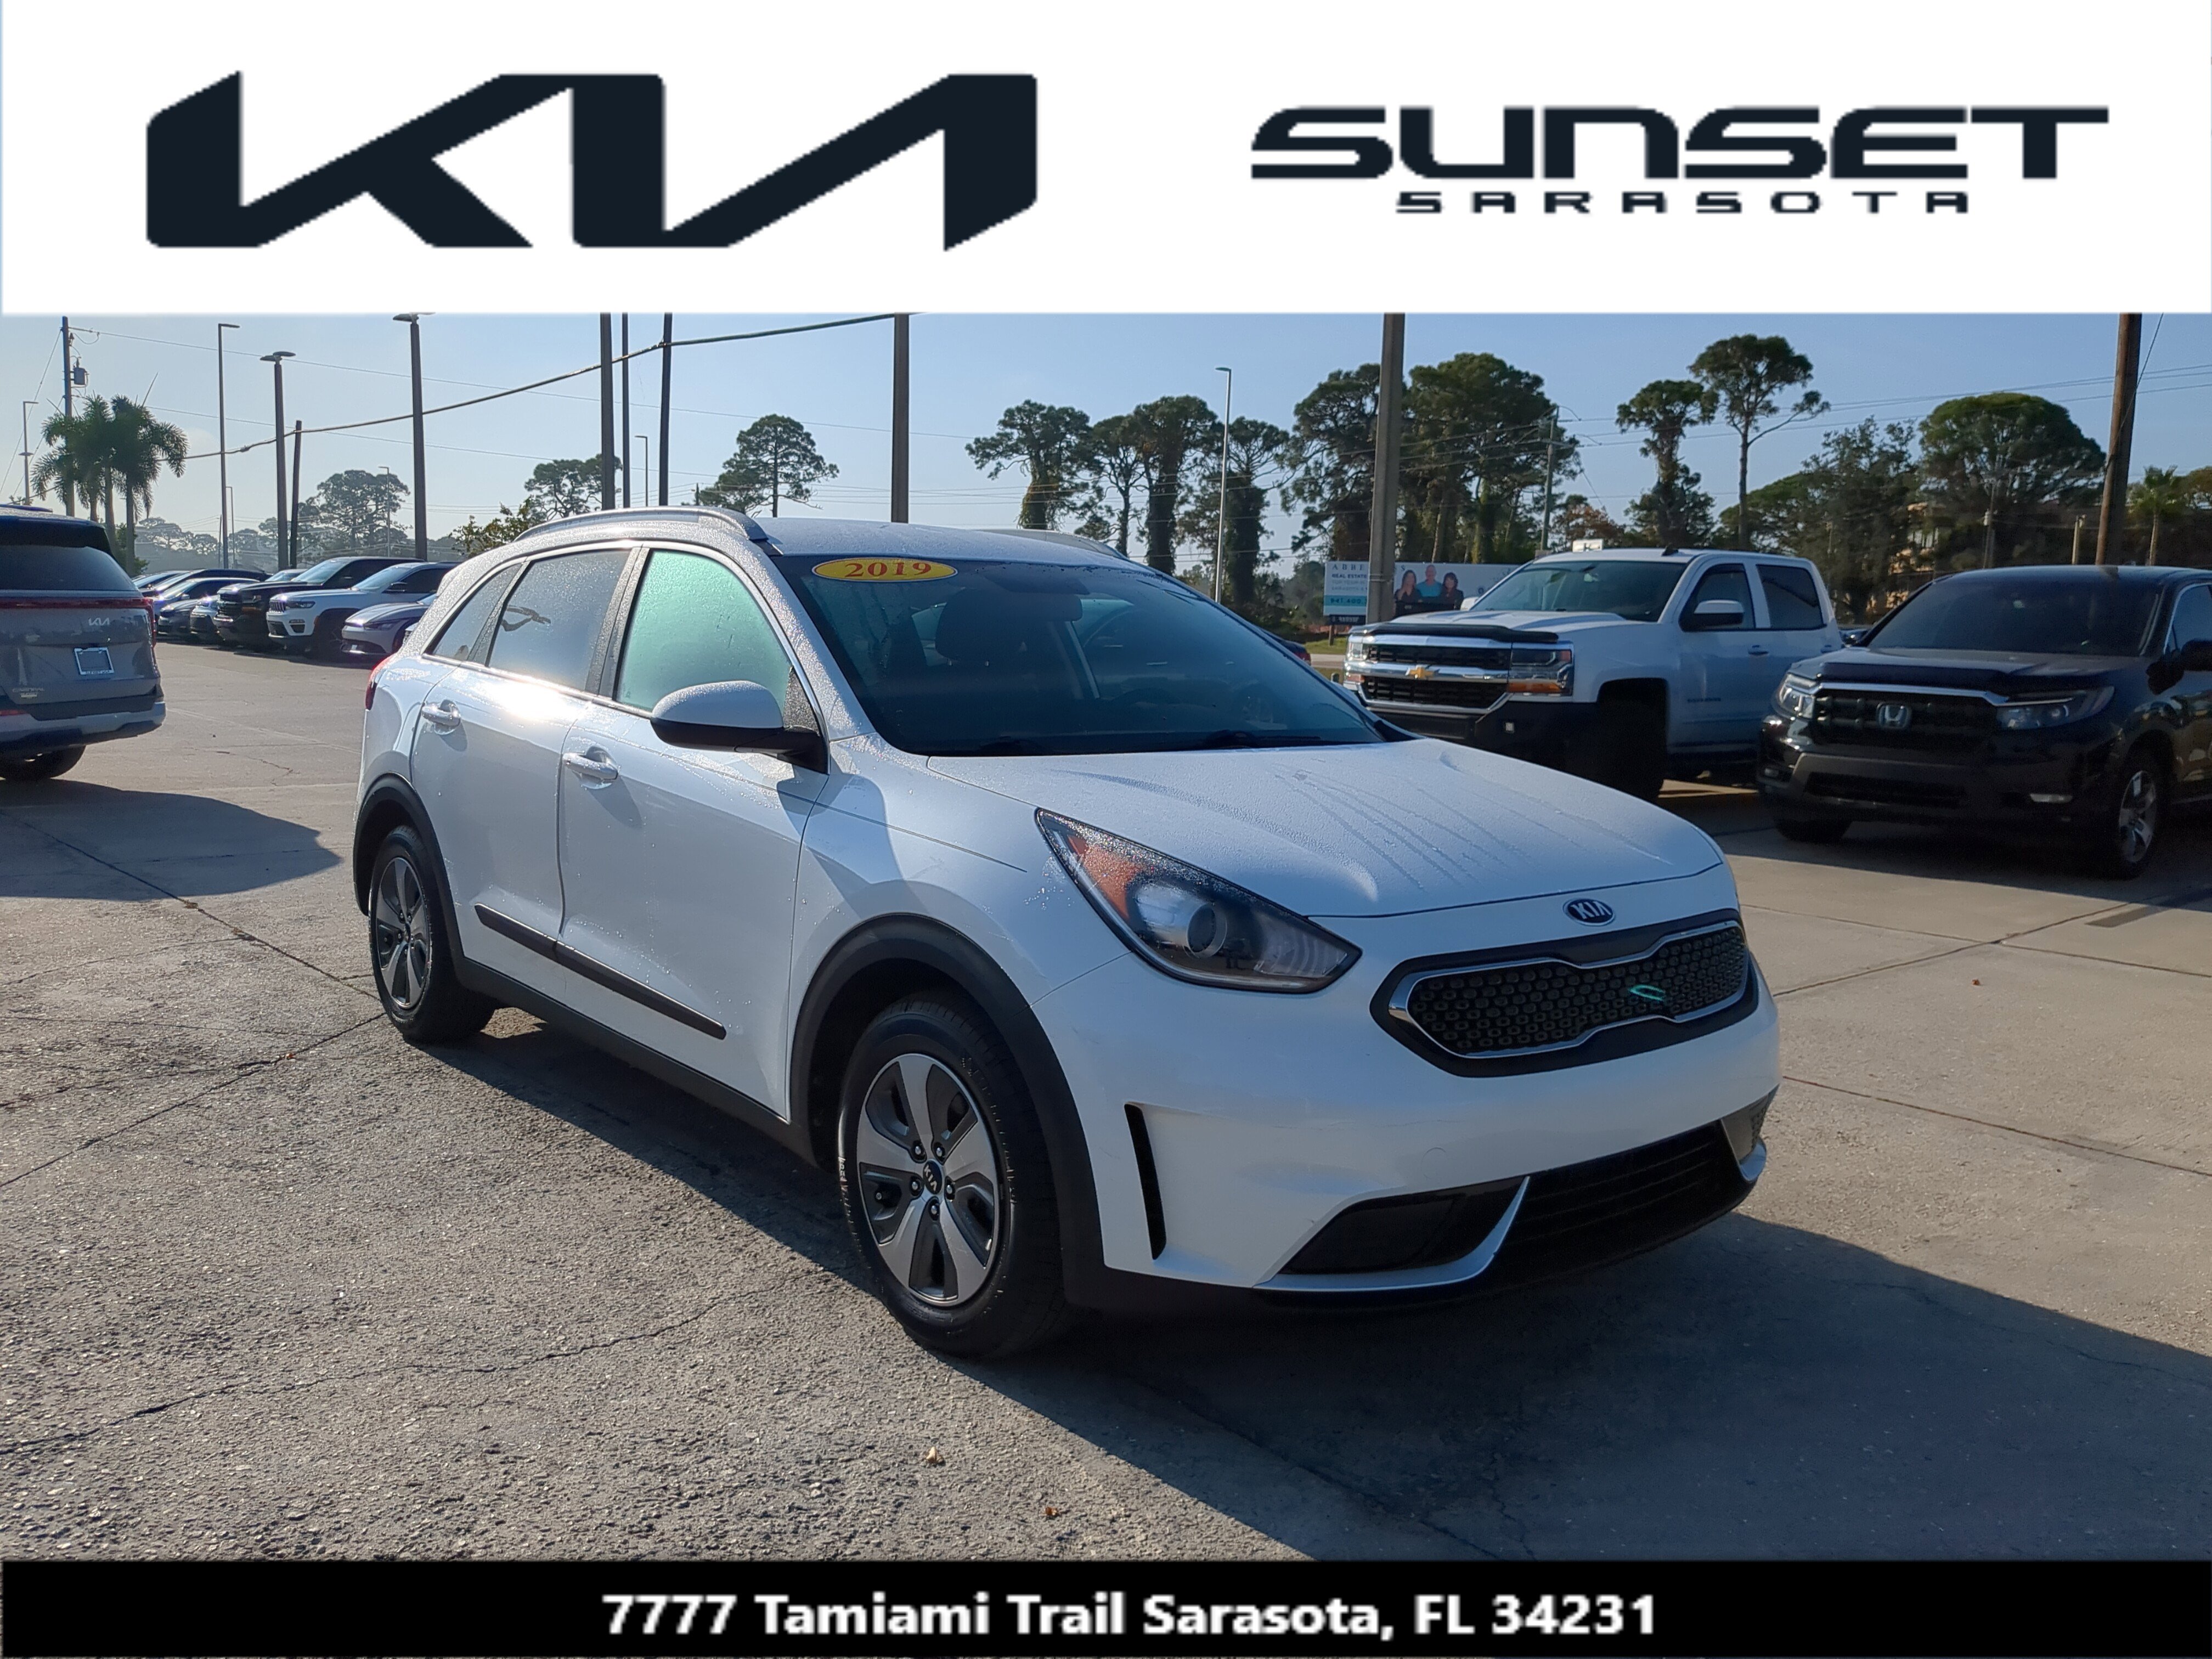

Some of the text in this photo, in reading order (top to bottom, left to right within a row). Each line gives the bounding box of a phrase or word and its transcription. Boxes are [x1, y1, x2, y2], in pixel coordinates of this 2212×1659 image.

[845, 562, 932, 577] 2019
[1570, 901, 1612, 919] KIA
[924, 1164, 938, 1192] KIA
